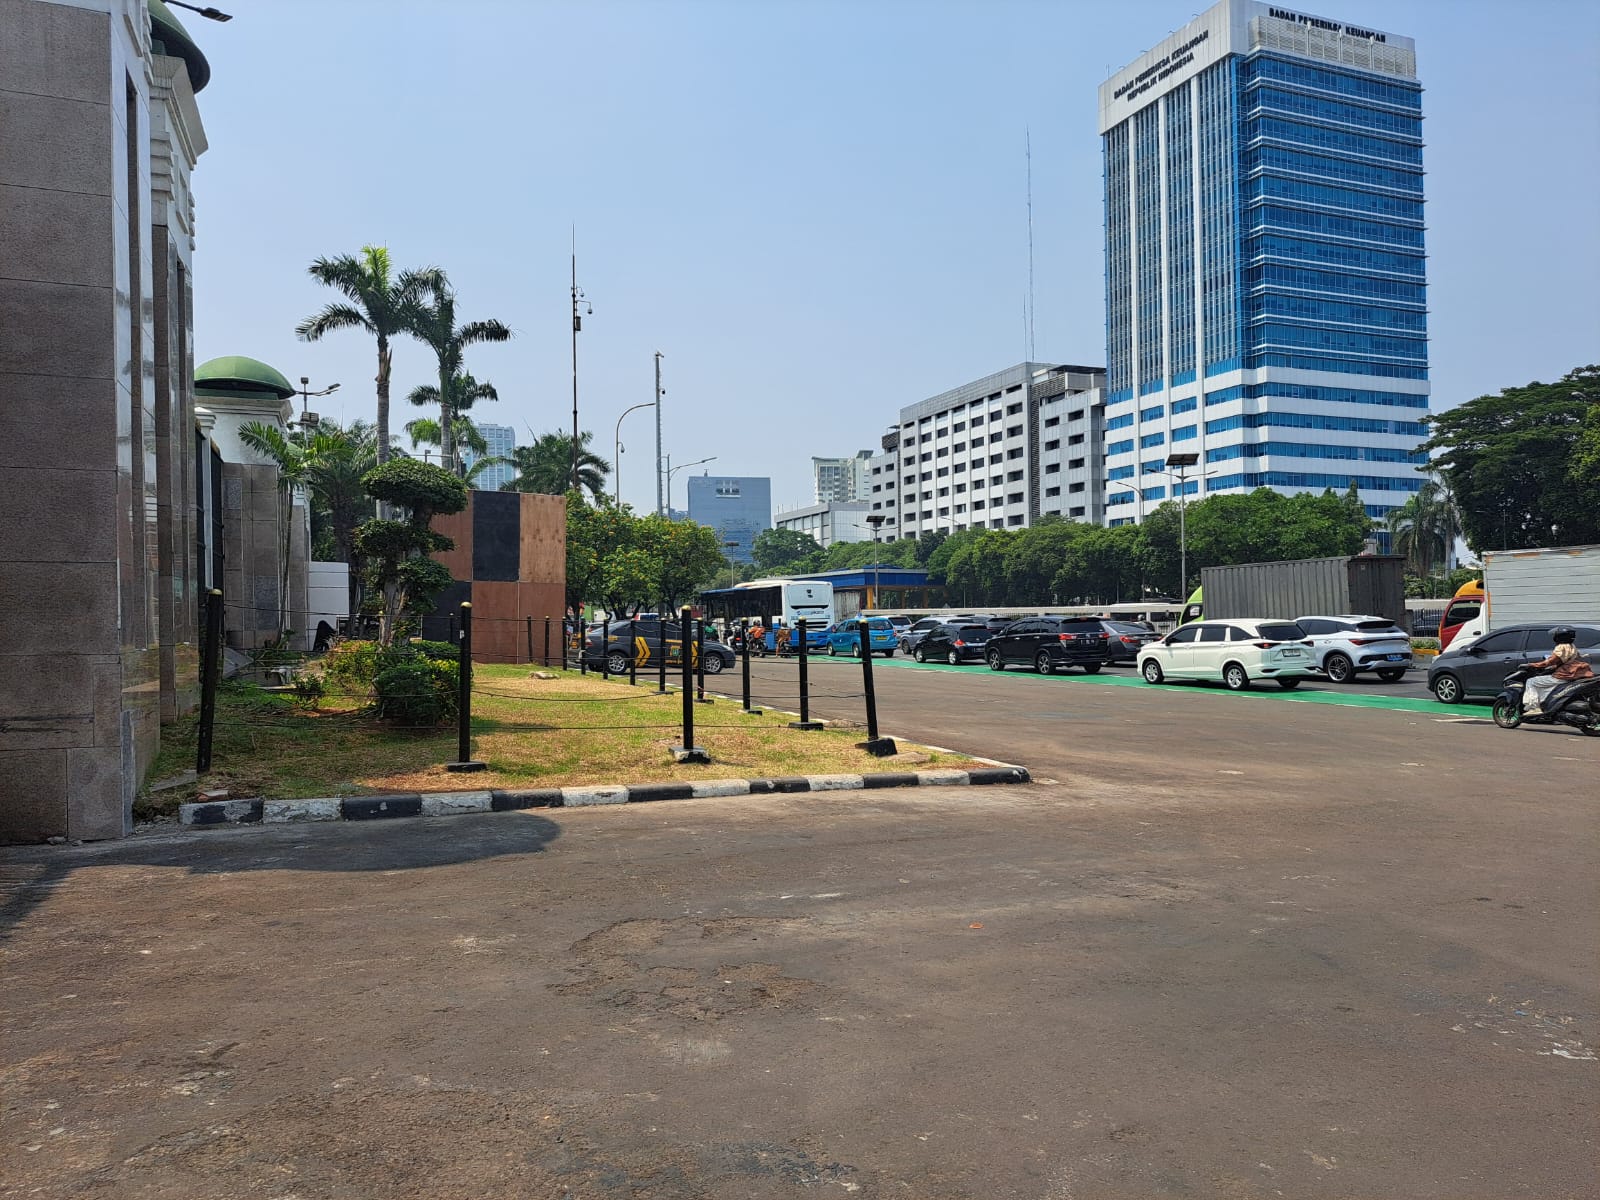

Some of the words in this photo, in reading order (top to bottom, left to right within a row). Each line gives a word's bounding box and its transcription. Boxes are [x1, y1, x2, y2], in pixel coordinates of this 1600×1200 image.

[1269, 7, 1296, 22] BADAN
[1114, 79, 1134, 99] BADAN
[1135, 56, 1170, 85] PEMERIKSA
[1172, 29, 1209, 61] KEUANGAN
[1127, 75, 1157, 101] REPUBLIK
[1158, 52, 1194, 81] INDONESIA
